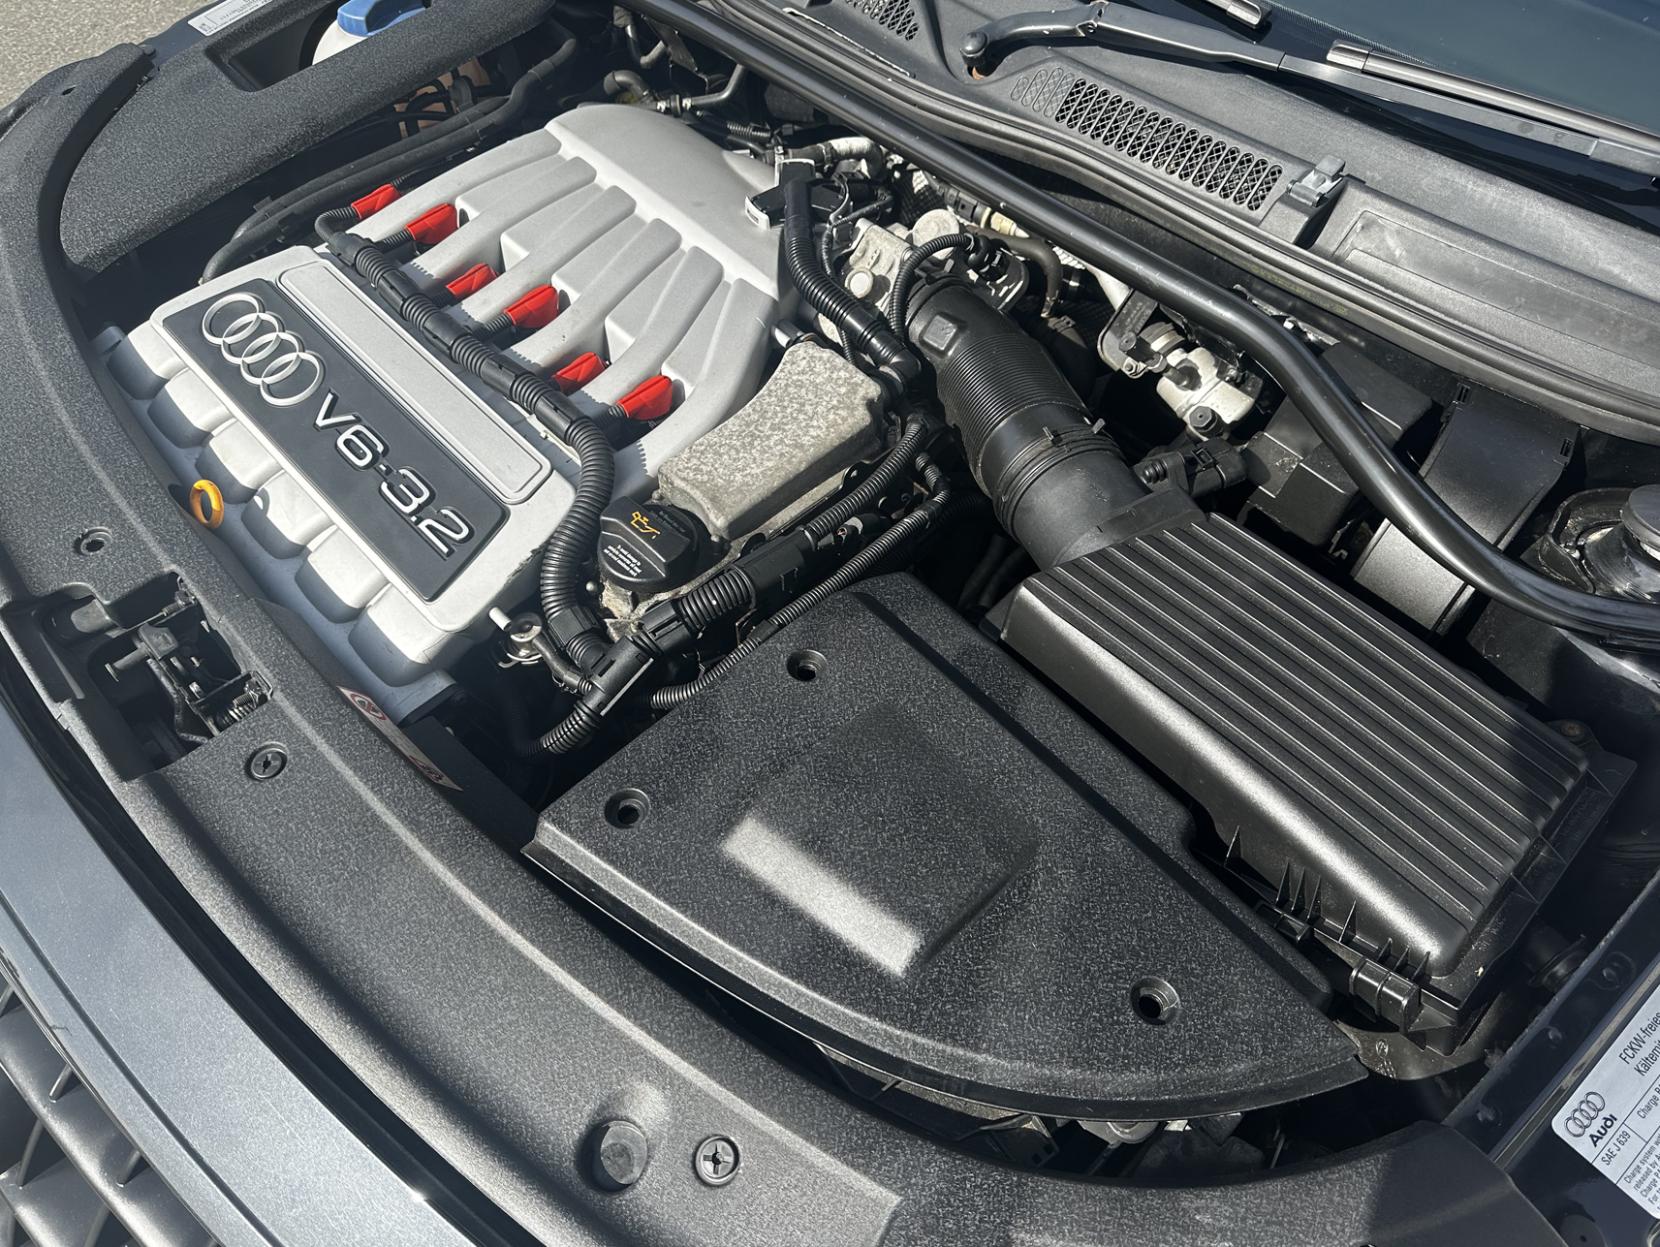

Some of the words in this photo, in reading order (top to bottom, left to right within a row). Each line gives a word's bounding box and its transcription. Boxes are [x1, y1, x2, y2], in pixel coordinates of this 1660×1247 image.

[1636, 1094, 1659, 1119] Charge
[1589, 1113, 1618, 1148] Audi
[1616, 1130, 1631, 1146] 639
[1601, 1147, 1617, 1166] SAE
[1612, 1142, 1621, 1152] J
[1623, 1164, 1642, 1184] Charge
